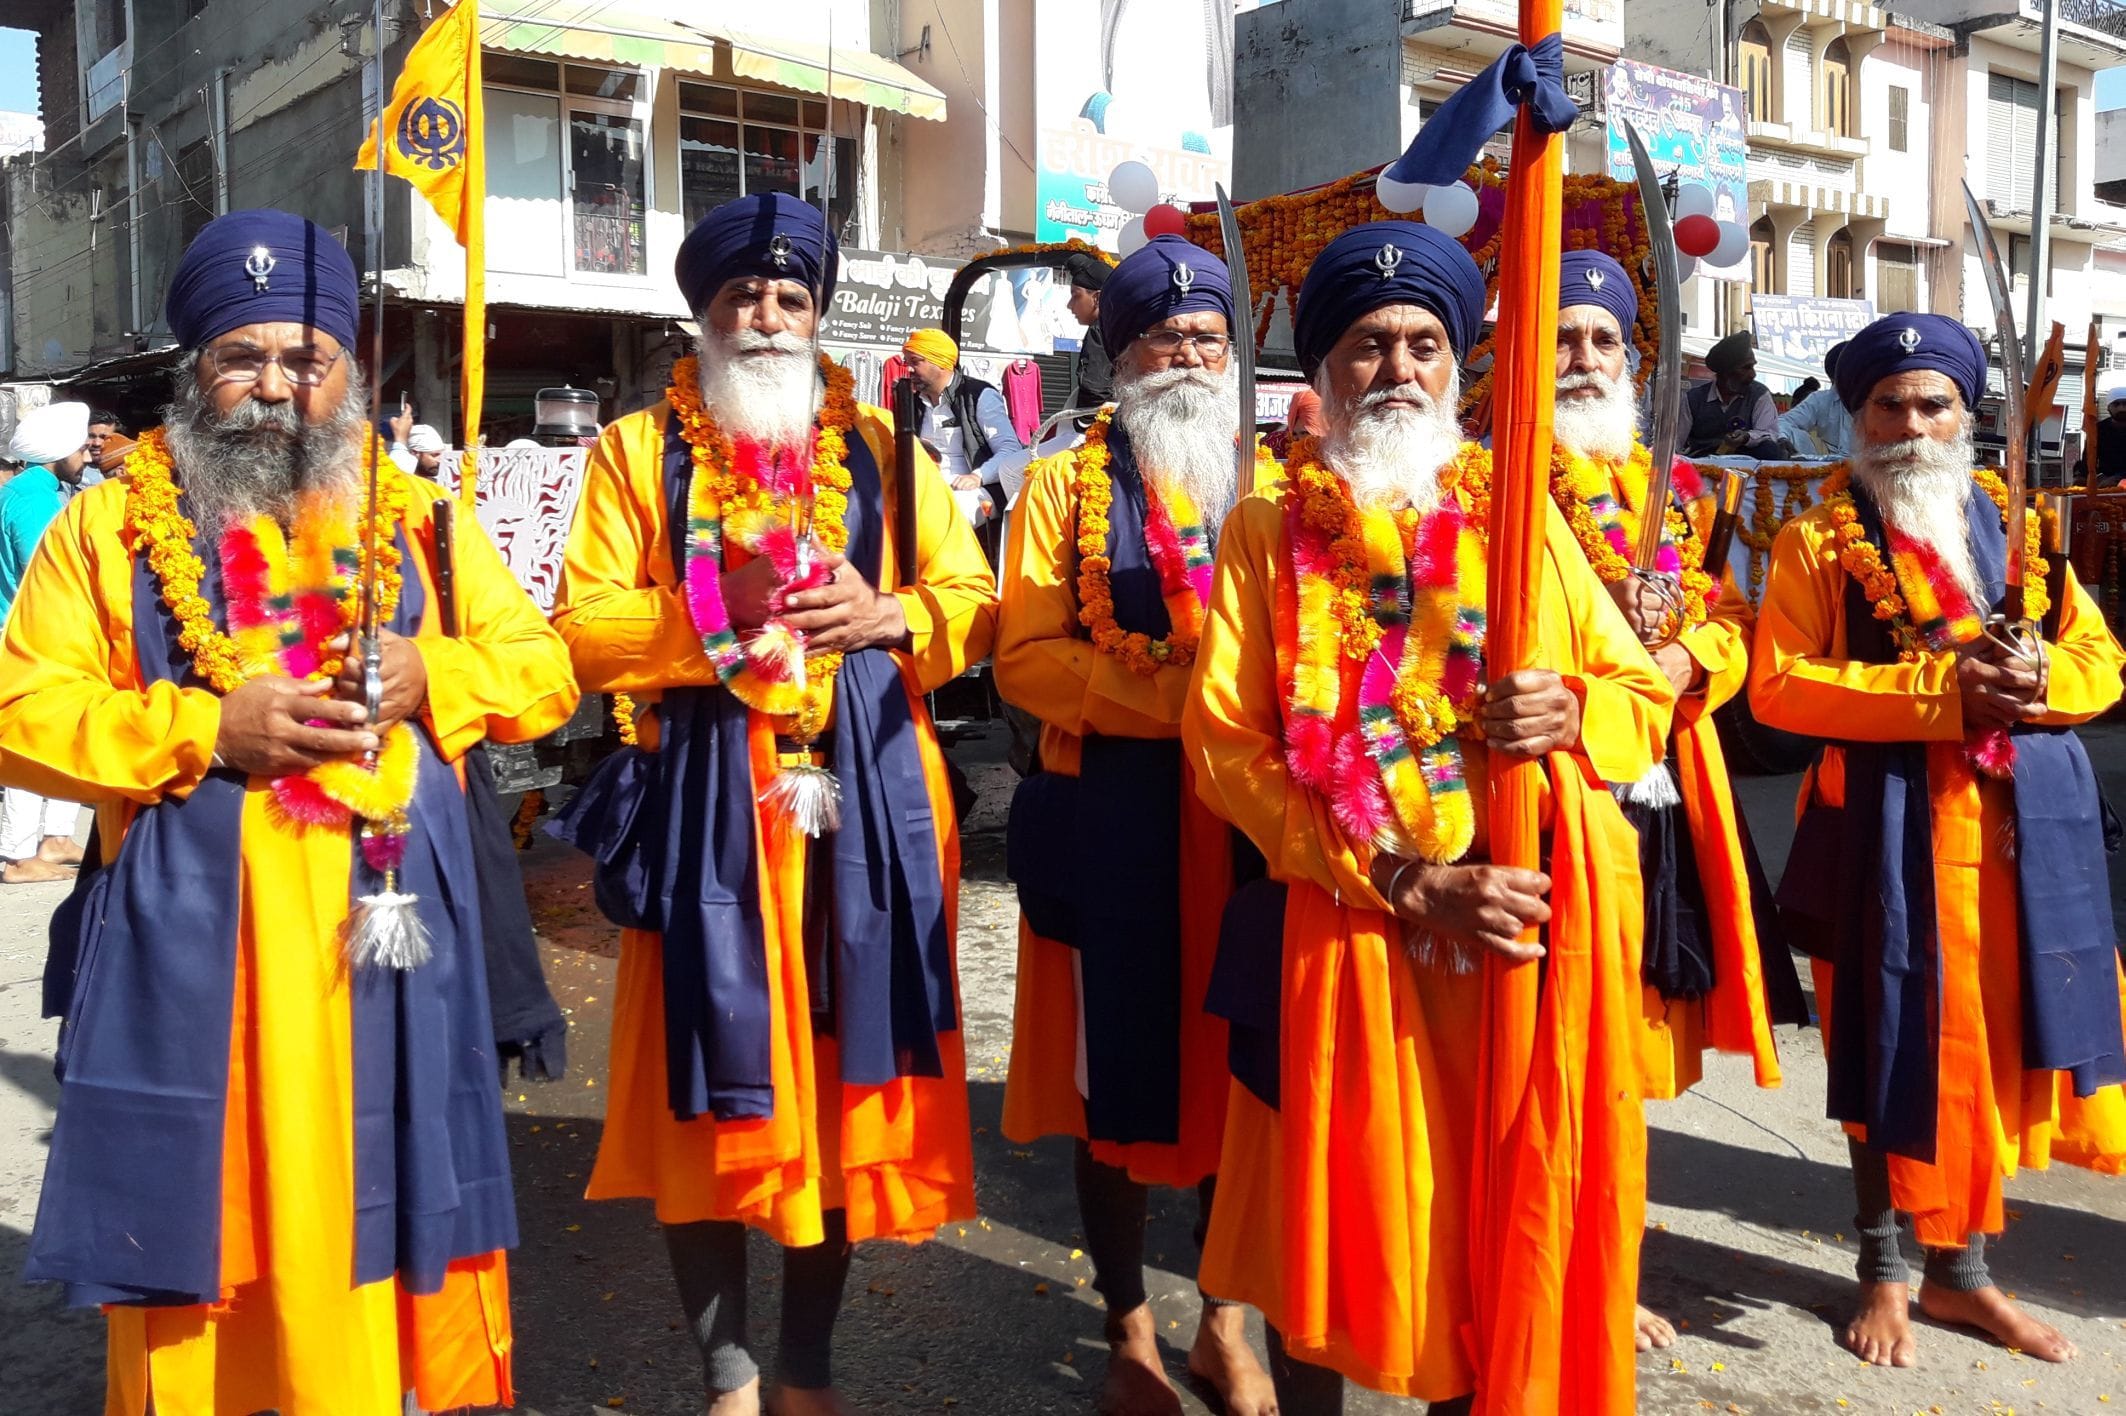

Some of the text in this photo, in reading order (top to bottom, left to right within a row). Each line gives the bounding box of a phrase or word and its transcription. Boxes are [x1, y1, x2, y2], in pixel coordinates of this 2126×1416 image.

[834, 289, 976, 324] Balaji Texes
[838, 319, 858, 330] Fancy
[885, 324, 905, 334] Fancy
[838, 330, 858, 341] Fancy
[885, 334, 905, 345] Fancy
